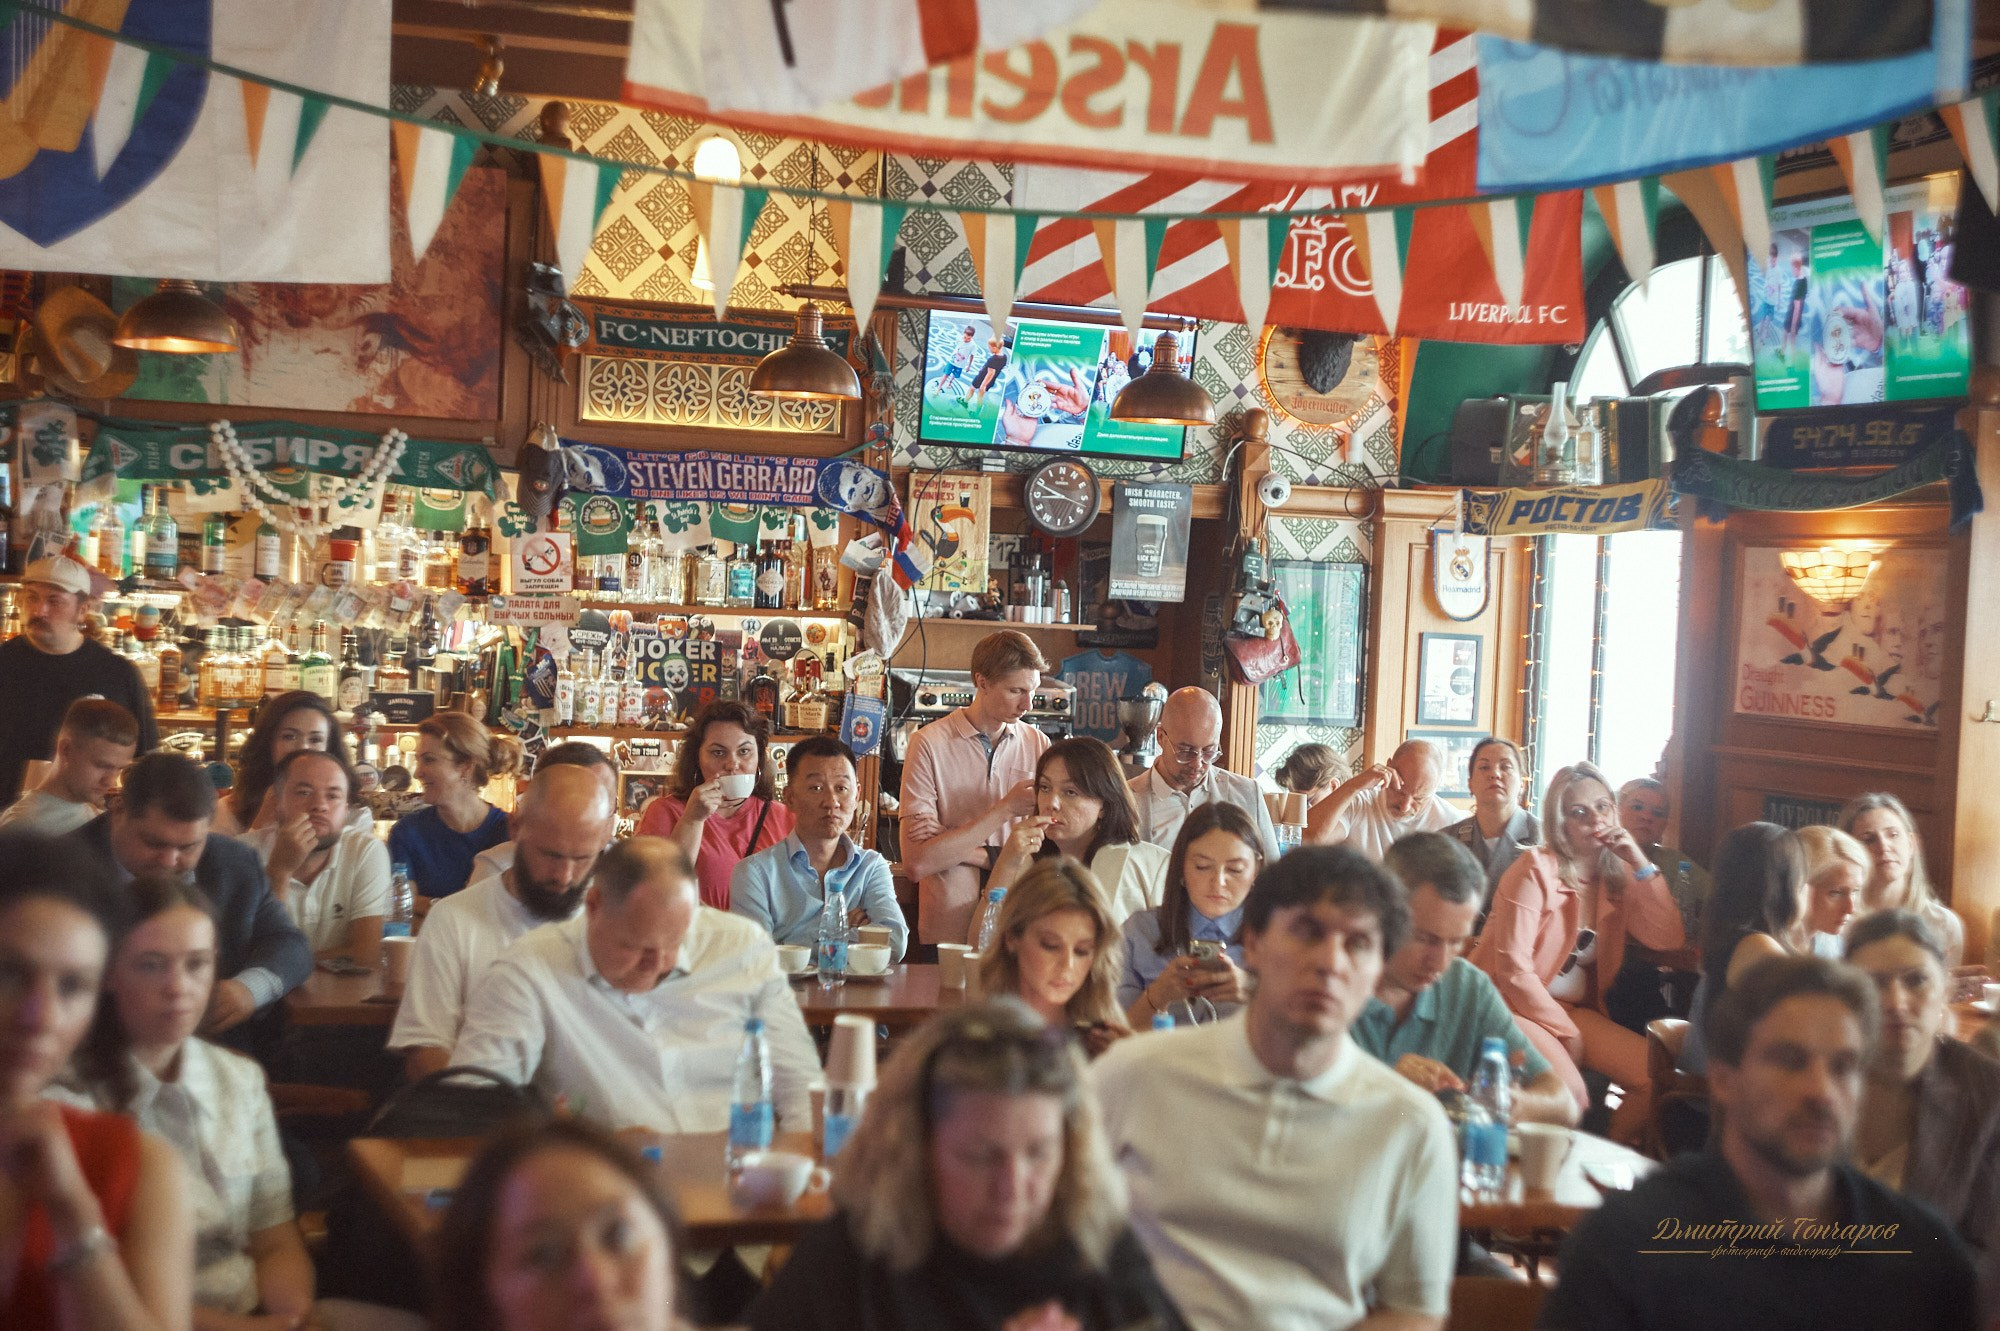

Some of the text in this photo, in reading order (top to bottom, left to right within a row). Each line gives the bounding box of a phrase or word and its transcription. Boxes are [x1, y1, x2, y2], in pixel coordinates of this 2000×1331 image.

[1538, 304, 1568, 325] FC
[650, 326, 792, 351] NEFTOCHI
[627, 460, 818, 494] STEVEN GERRARD
[941, 480, 956, 491] day
[958, 481, 972, 490] for
[630, 488, 813, 504] NO ONE LIKES US WE DON'T CARE
[913, 489, 955, 501] GUINNESS
[1124, 487, 1183, 500] IRISH CHARACTER.
[1128, 497, 1155, 508] SMOOTH
[1507, 492, 1644, 526] РОСТОВ
[629, 554, 641, 565] 51
[508, 599, 561, 610] ПАЛАТА ДЛЯ
[533, 611, 575, 621] БОЛЬНЫХ
[633, 639, 717, 661] JOKER
[634, 661, 718, 683] JOER
[1739, 684, 1837, 719] GUINNESS
[1073, 702, 1117, 730] DOG
